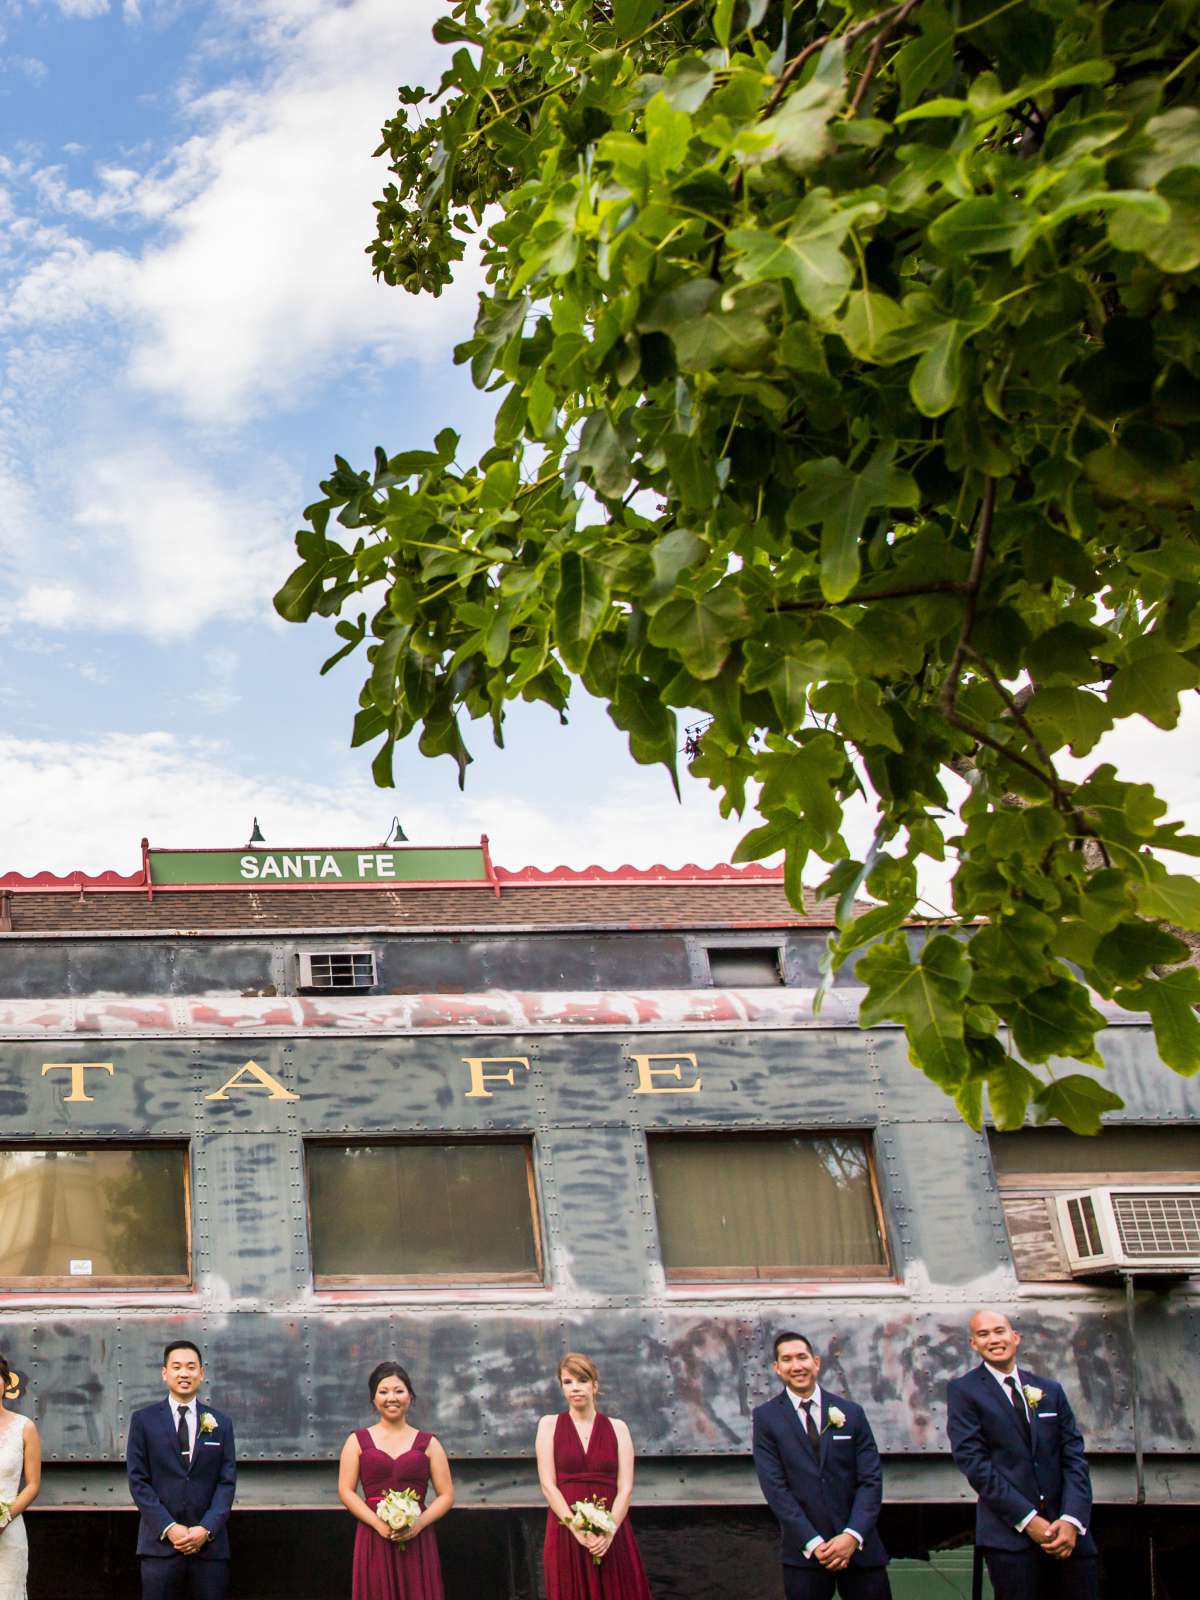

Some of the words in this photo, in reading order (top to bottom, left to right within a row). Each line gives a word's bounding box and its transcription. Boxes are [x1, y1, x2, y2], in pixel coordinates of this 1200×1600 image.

[240, 855, 342, 879] SANTA
[358, 854, 396, 877] FE
[462, 1052, 701, 1097] FE
